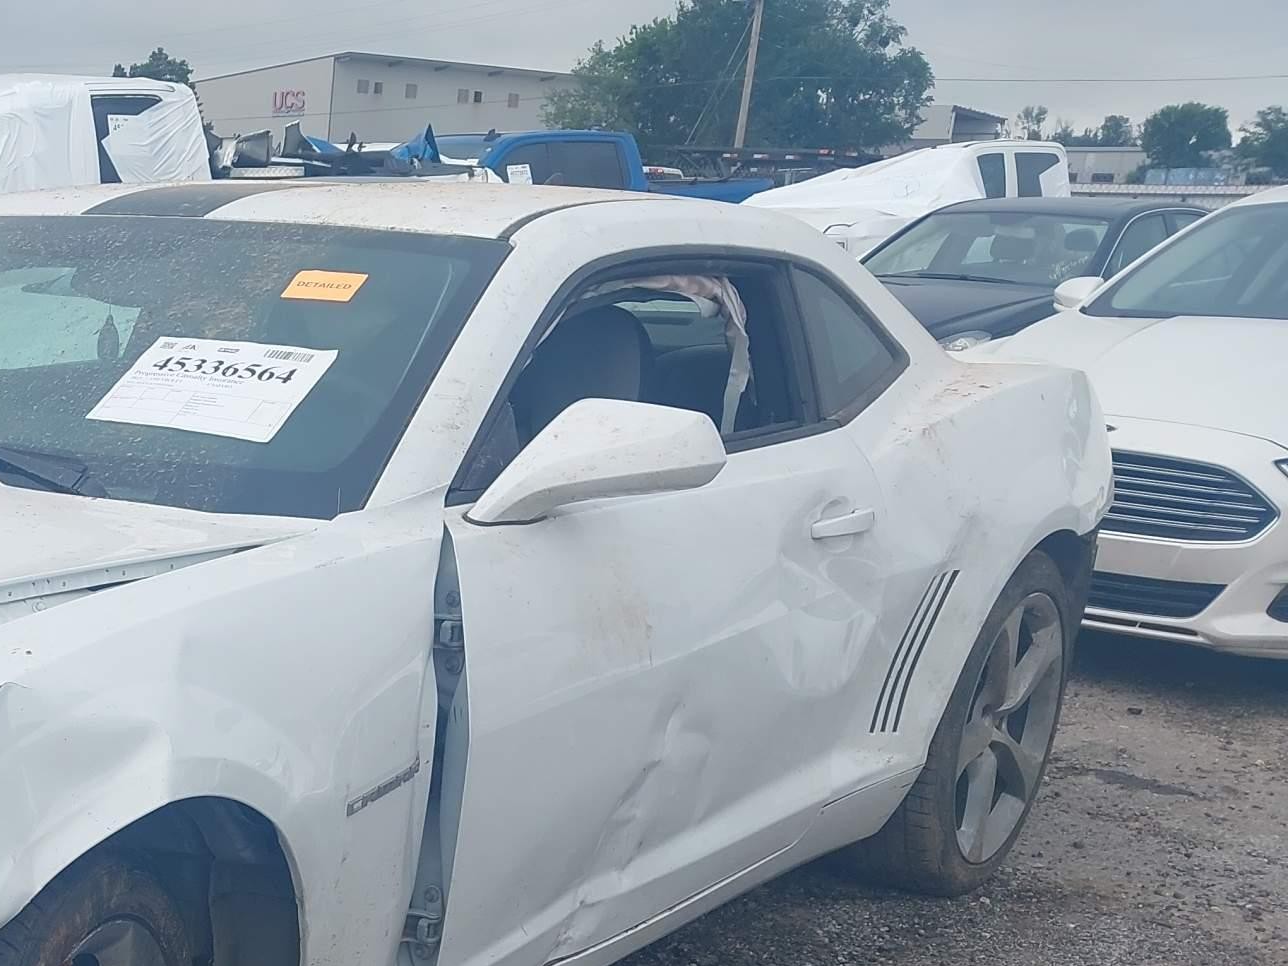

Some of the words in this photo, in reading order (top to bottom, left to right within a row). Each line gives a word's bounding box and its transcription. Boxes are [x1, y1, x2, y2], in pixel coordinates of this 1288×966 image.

[273, 90, 306, 112] UCS
[297, 281, 352, 290] DETAILED
[153, 356, 297, 384] 45336564
